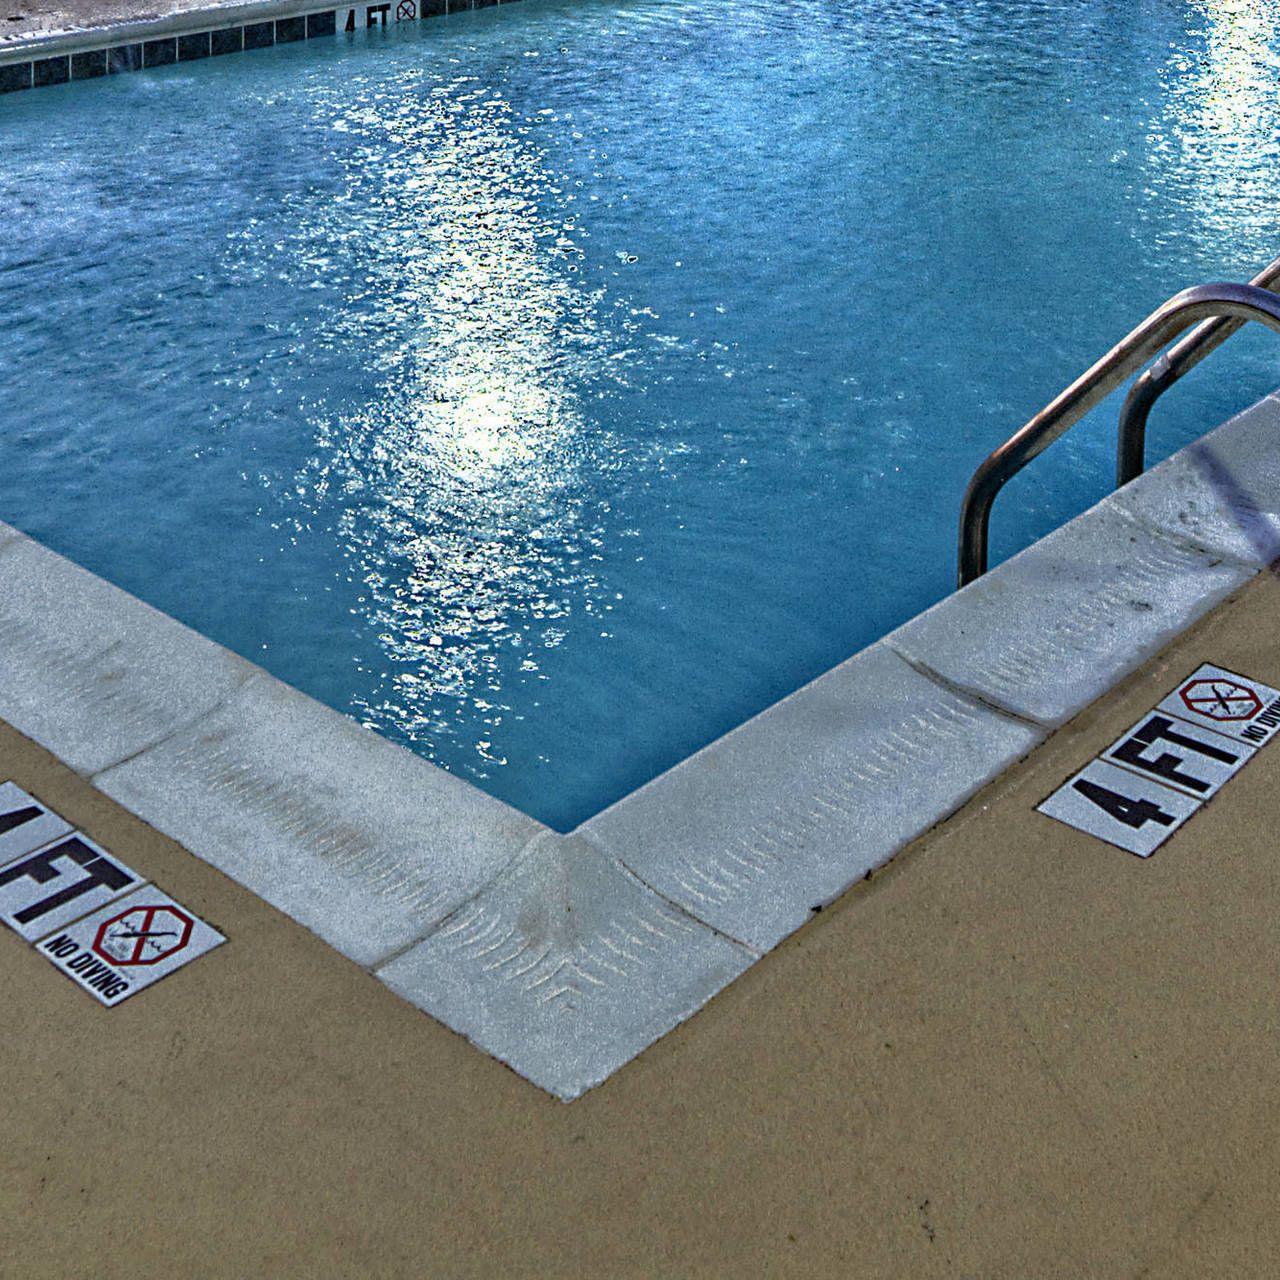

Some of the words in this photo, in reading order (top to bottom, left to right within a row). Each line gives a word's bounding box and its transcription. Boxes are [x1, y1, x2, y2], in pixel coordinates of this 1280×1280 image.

[366, 3, 391, 28] FT
[1111, 715, 1240, 793] FT
[1240, 725, 1268, 742] NO
[1072, 778, 1177, 829] 4
[44, 934, 80, 959] NO
[66, 952, 129, 999] DIVING
